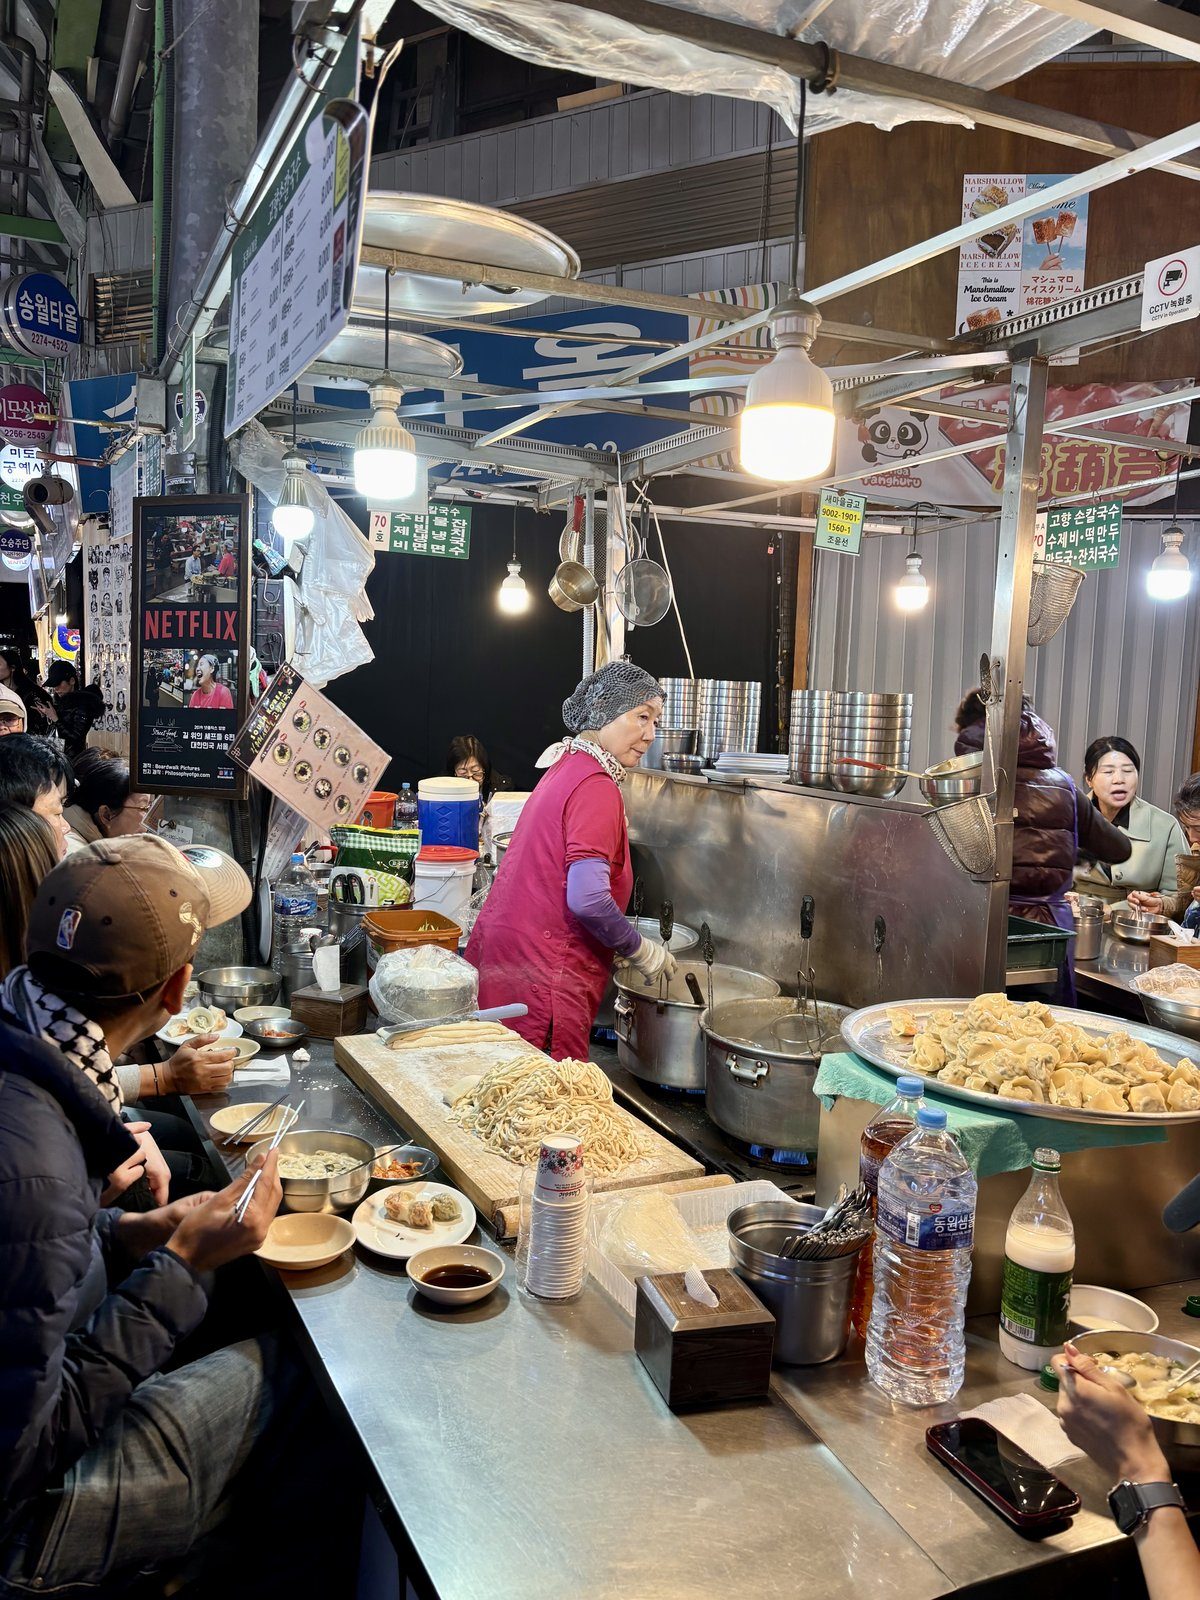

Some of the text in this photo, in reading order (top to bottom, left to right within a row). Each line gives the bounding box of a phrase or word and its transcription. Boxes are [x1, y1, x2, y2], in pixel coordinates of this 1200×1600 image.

[1032, 276, 1074, 284] マシュマロ
[963, 285, 1016, 294] Marshmallow
[1022, 285, 1081, 294] アイスクリーム
[970, 295, 1007, 303] Ice Cream
[1149, 294, 1193, 315] CCTV 녹화중
[19, 290, 78, 334] 송월타올
[1152, 313, 1164, 322] CCTV
[1169, 307, 1190, 317] Operation
[32, 332, 68, 352] 2274-4522
[4, 429, 46, 439] 2266-2549
[10, 448, 35, 459] 미도
[3, 460, 44, 475] 공예사
[825, 495, 860, 509] 새마을금고
[428, 505, 460, 517] 칼국수
[822, 508, 860, 522] 9002-1901-
[1049, 503, 1120, 528] 고향 손칼국수
[374, 515, 387, 528] 70
[393, 513, 412, 551] 수제비
[412, 514, 430, 553] 비빔냉면
[828, 523, 851, 534] 1560-1
[375, 530, 384, 543] 호
[430, 516, 450, 555] 물냉면
[448, 518, 468, 556] 잔치국수
[827, 535, 849, 548] 조윤선
[1, 538, 30, 550] 오승주단
[145, 610, 237, 641] NETFLIX
[266, 690, 284, 714] KOREA
[151, 728, 166, 737] Street
[183, 731, 189, 739] 길
[191, 732, 203, 740] 위의
[224, 733, 235, 741] 6편
[190, 741, 229, 750] 대한민국 서울
[165, 770, 210, 778] Philosophyofgo.com
[934, 1212, 975, 1234] 동원샘물
